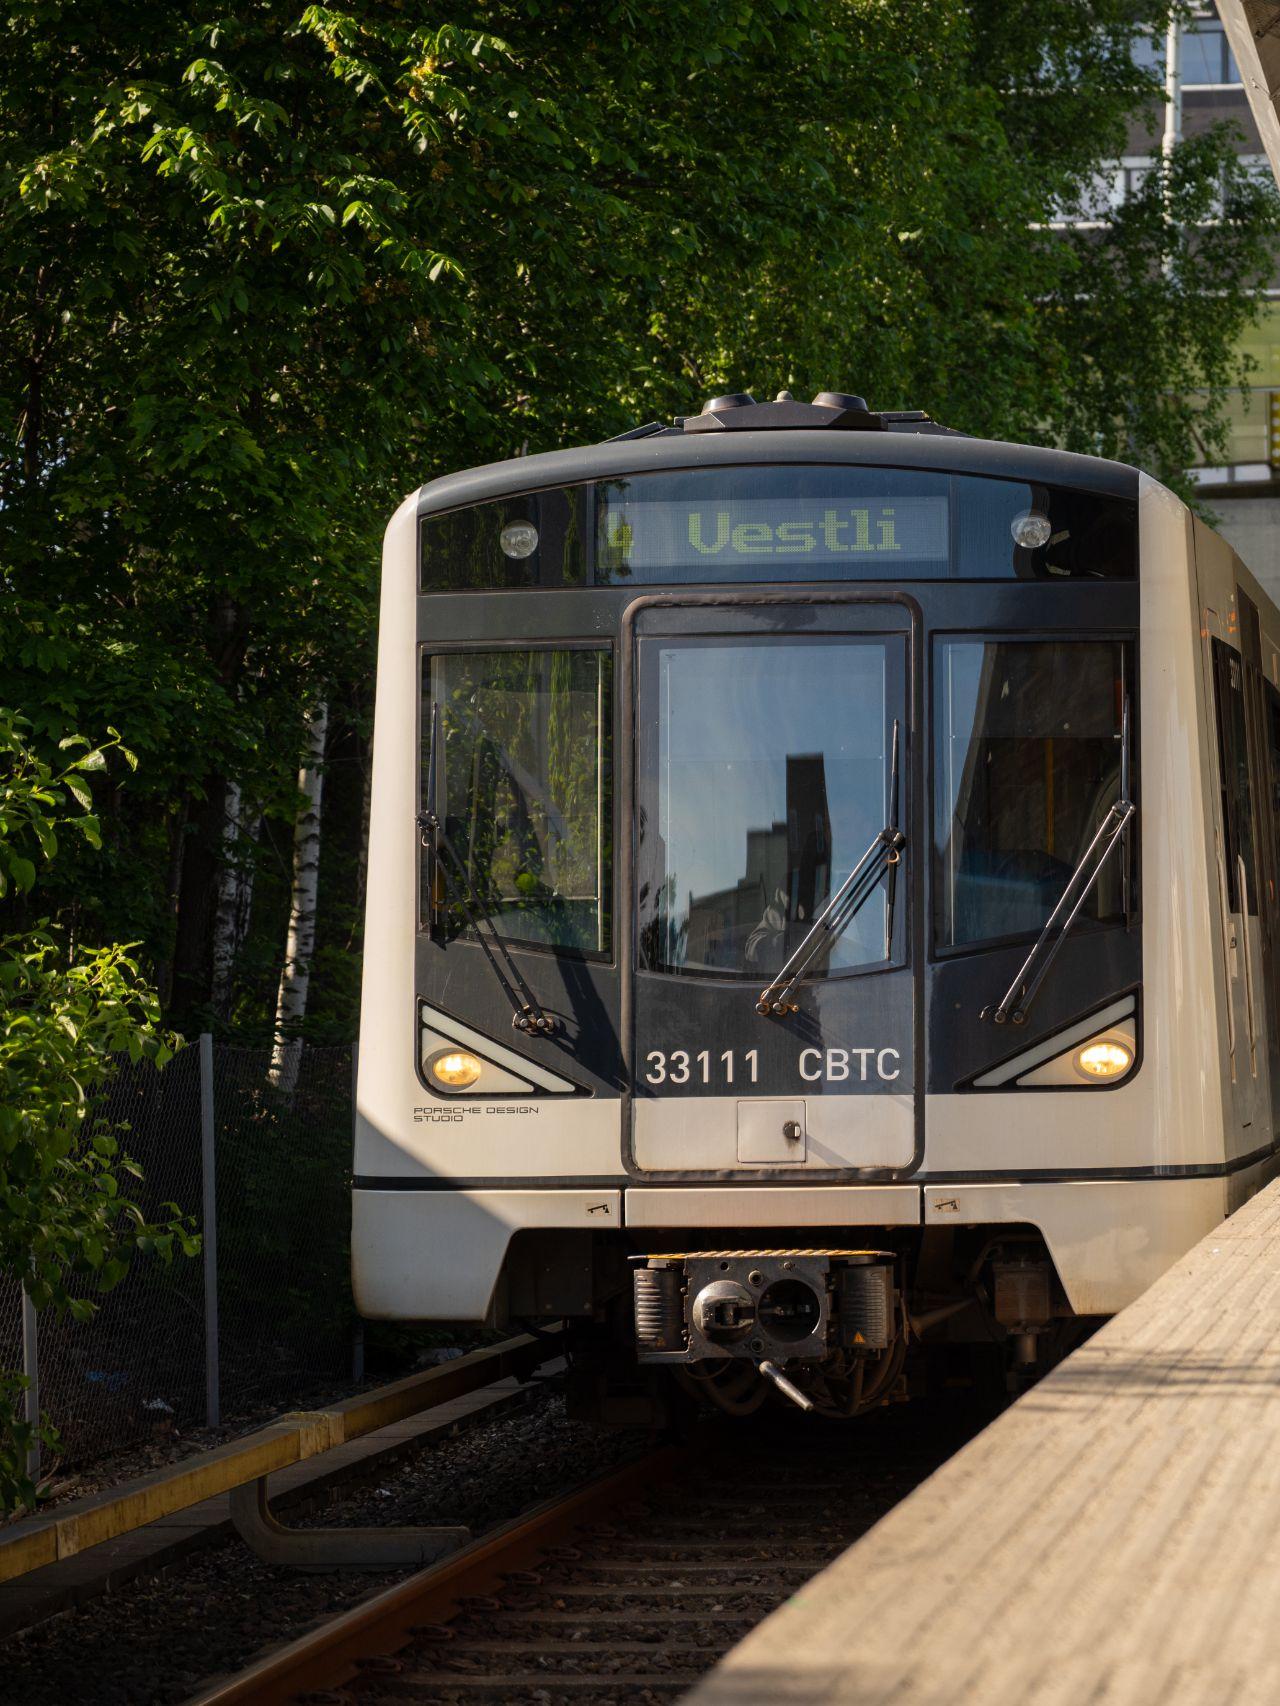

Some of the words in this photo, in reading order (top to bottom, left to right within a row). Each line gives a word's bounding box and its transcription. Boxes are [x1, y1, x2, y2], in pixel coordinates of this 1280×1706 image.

[688, 509, 902, 554] Vestli
[645, 1049, 758, 1084] 33111
[798, 1047, 901, 1081] CBTC
[413, 1106, 482, 1115] PORSCHE
[486, 1106, 539, 1114] DESIGN
